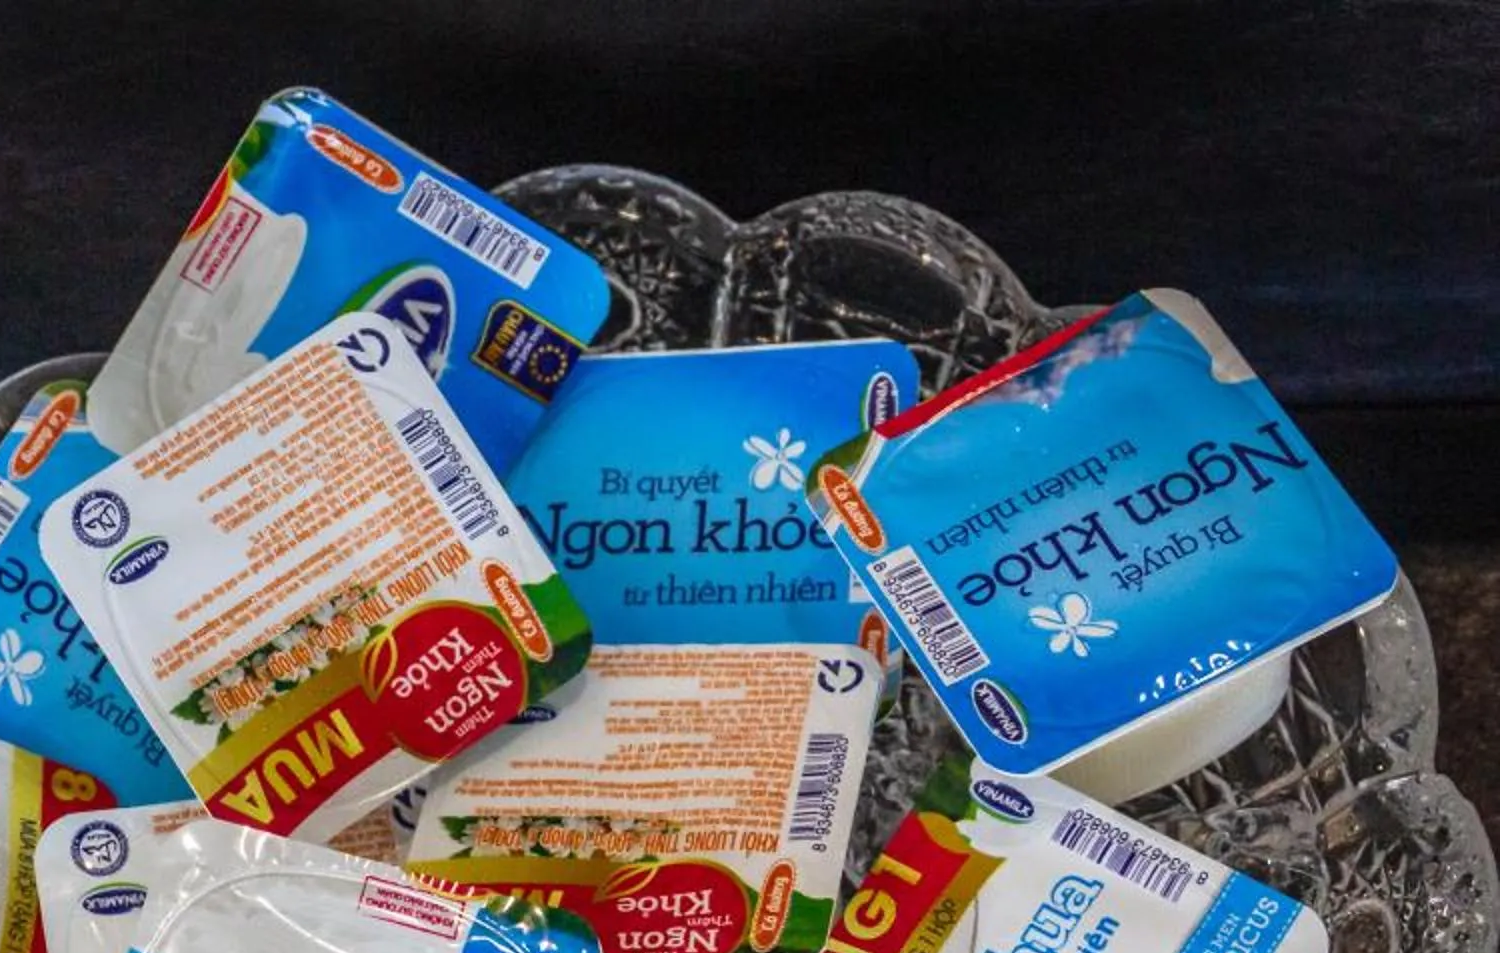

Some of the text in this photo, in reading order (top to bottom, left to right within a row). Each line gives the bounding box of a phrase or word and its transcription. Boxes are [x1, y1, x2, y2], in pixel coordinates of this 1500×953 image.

[601, 465, 722, 500] Bí quyết
[928, 457, 1105, 557] thiên nhiên
[957, 421, 1308, 608] Ngon khỏe
[494, 523, 510, 539] 8
[518, 498, 835, 571] Ngon khỏe
[110, 542, 169, 587] VINAMILK
[1110, 517, 1241, 592] Bí quyết
[656, 572, 836, 606] thiên nhiên
[518, 617, 540, 640] Có
[391, 627, 473, 699] Khỏe
[461, 639, 501, 676] Thêm
[66, 678, 143, 738] quyết
[424, 662, 512, 736] Ngon
[975, 681, 1022, 742] VINAMILK
[453, 703, 495, 740] Thêm
[218, 707, 364, 824] MUA
[52, 768, 97, 805] 8
[975, 781, 1034, 819] VINAMILK
[811, 842, 826, 852] 8
[873, 853, 923, 889] 1
[1196, 870, 1209, 886] 8
[616, 888, 712, 917] Khỏe
[686, 912, 732, 926] Thêm
[618, 924, 718, 951] Ngon
[1208, 912, 1241, 952] MEN
